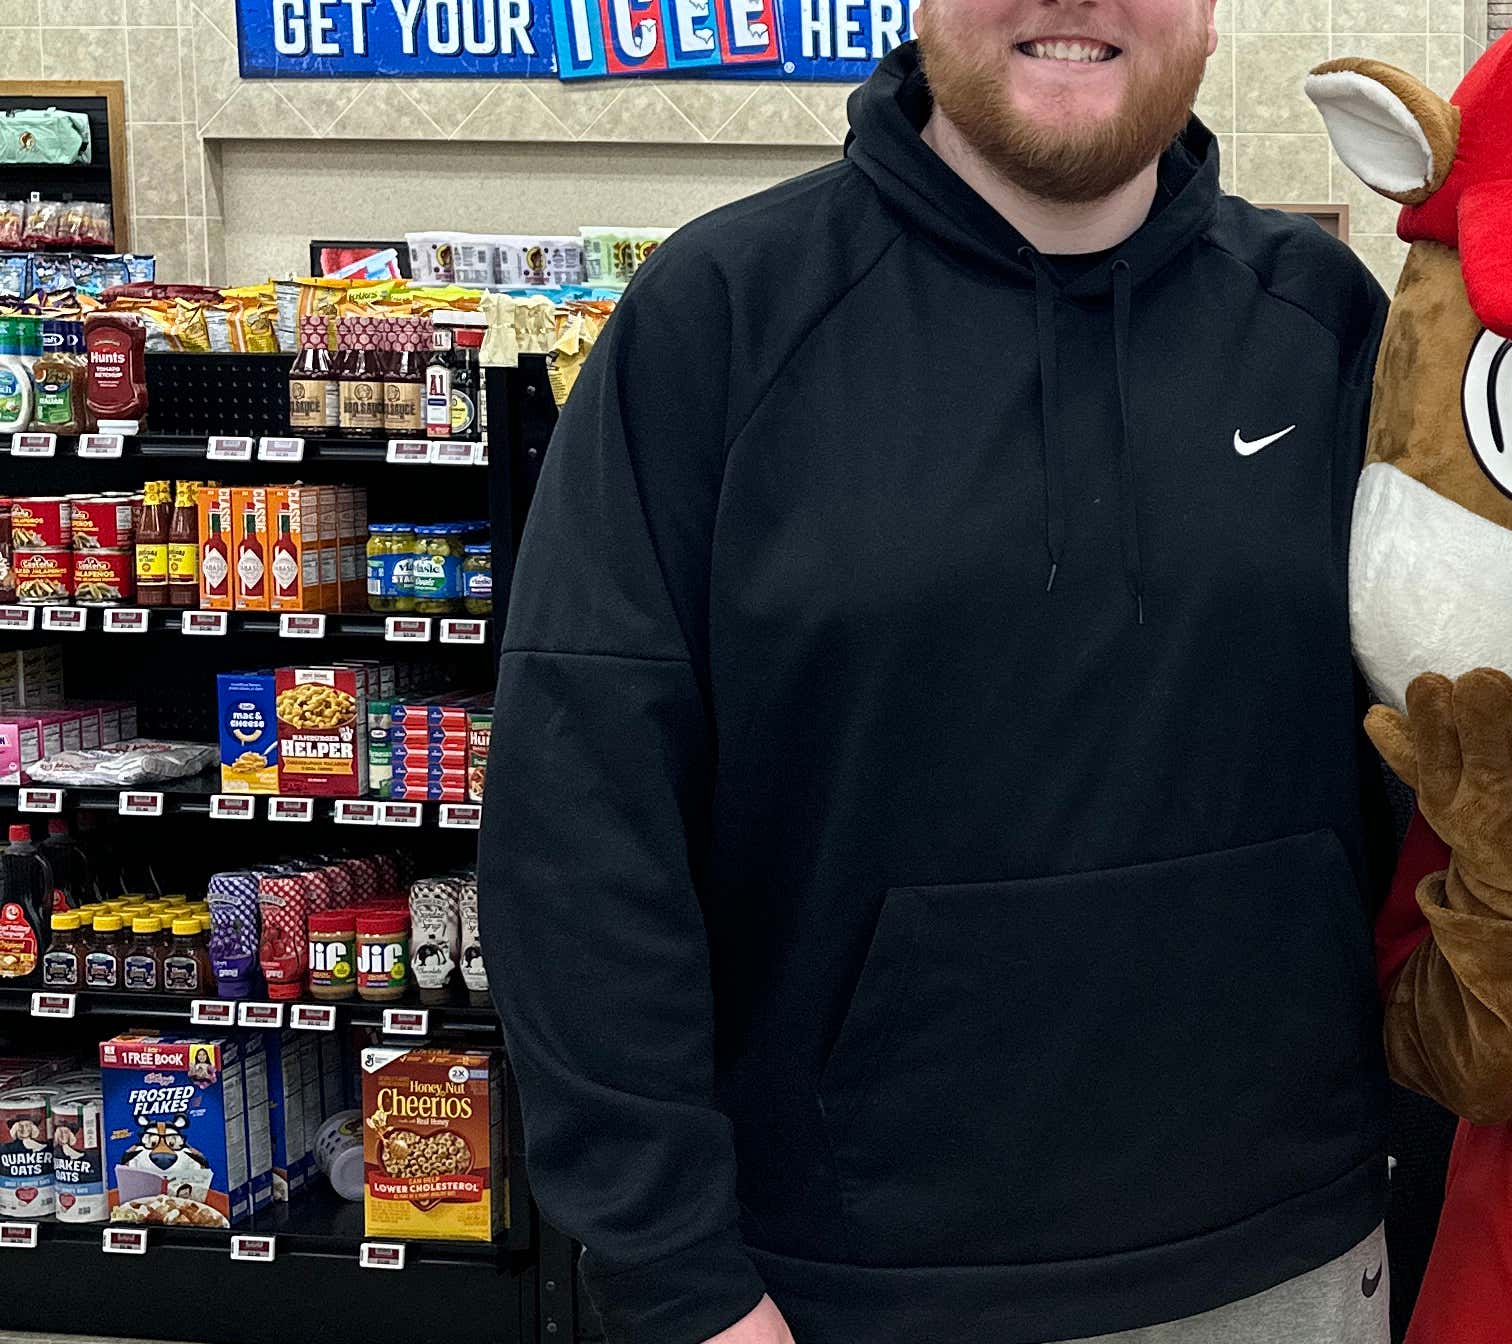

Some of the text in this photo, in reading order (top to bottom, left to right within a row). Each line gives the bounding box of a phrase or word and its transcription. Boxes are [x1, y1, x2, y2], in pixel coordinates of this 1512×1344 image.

[219, 488, 231, 532] CLASSIC
[253, 489, 267, 533] CLASSIC
[287, 490, 301, 533] CLASSIC
[281, 739, 353, 758] HELPER
[357, 943, 403, 973] Jif
[122, 1052, 183, 1065] 1 FREE BOOK
[128, 1086, 195, 1103] FROSTED
[410, 1081, 442, 1096] Honey
[445, 1081, 465, 1094] Nut
[133, 1099, 190, 1116] FLAKES
[377, 1088, 473, 1119] Cheerios
[1, 1152, 53, 1167] QUAKER
[54, 1158, 91, 1173] UAKER
[10, 1164, 42, 1176] OATS
[56, 1170, 80, 1183] OATS
[374, 1181, 479, 1194] LOWER CHOLESTEROL
